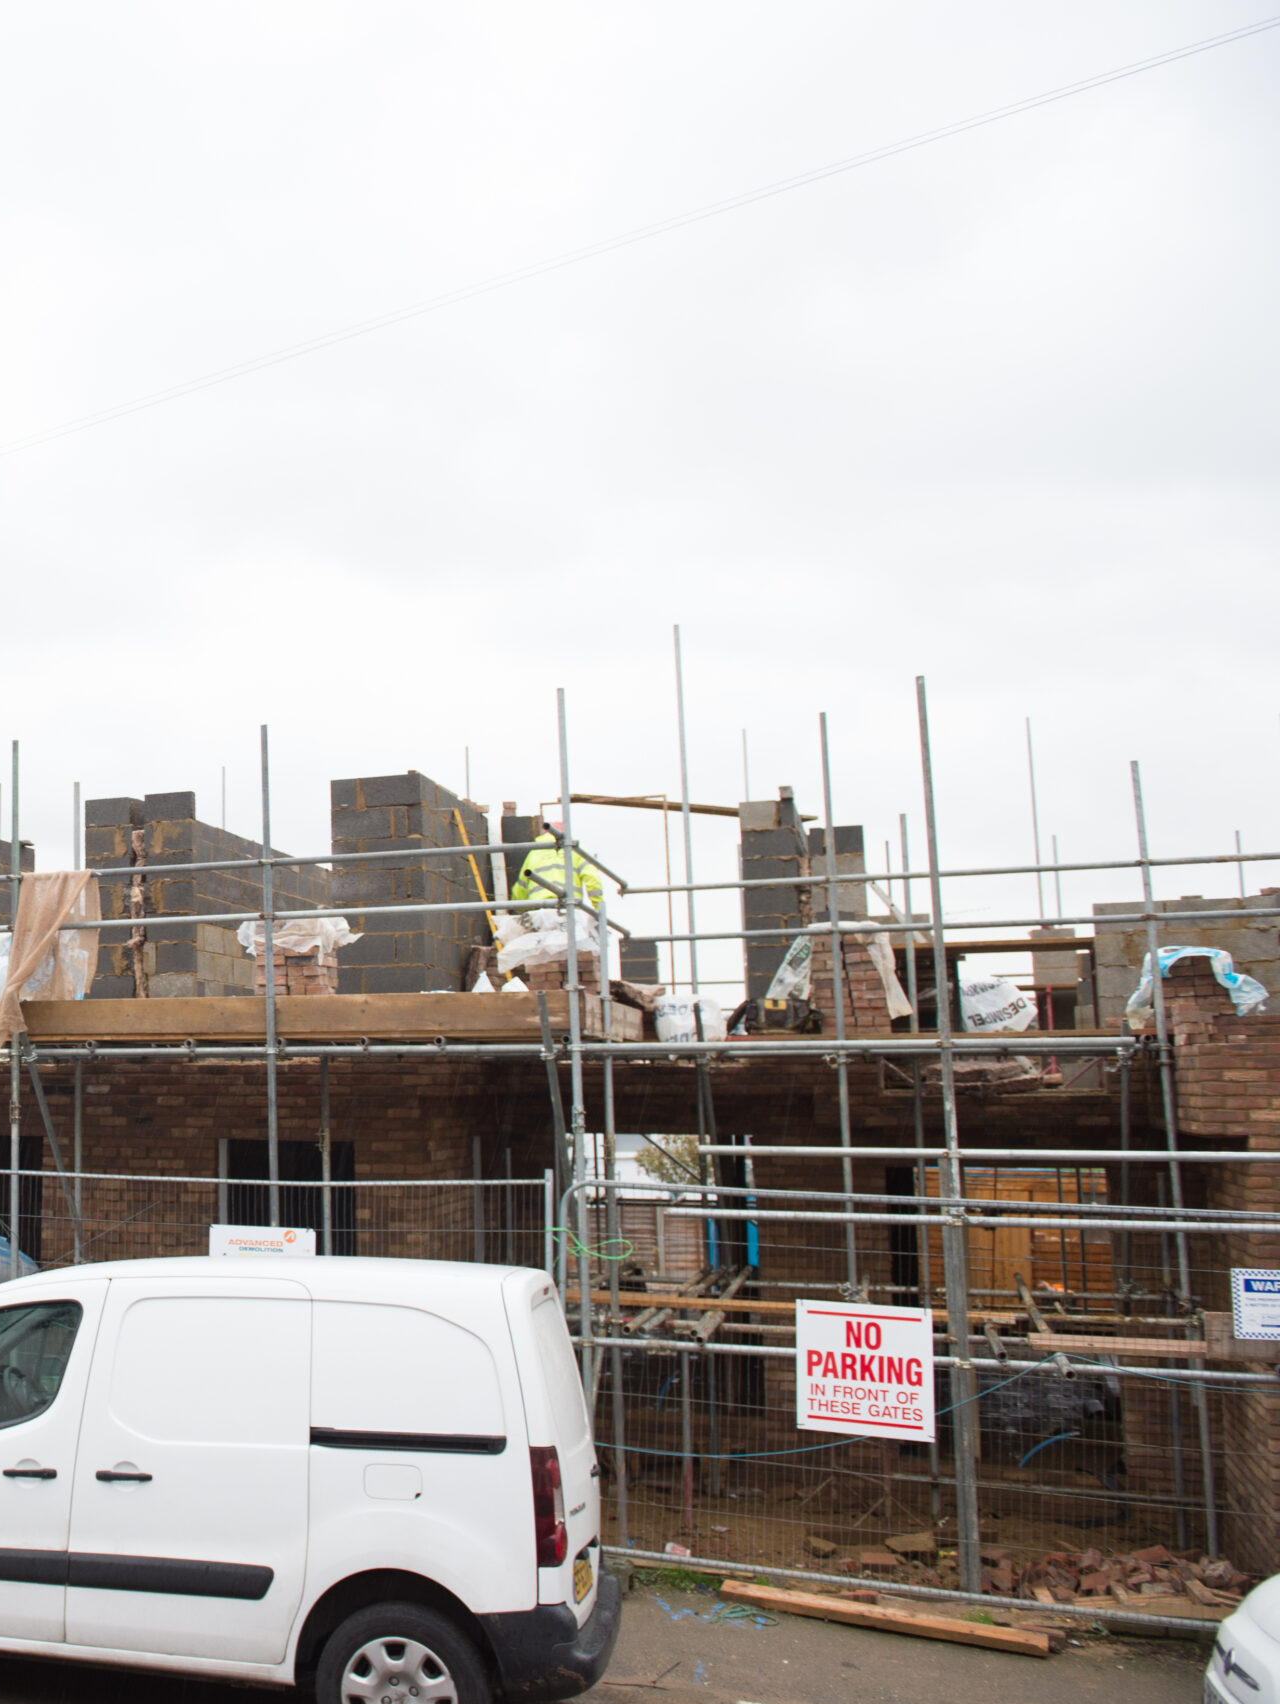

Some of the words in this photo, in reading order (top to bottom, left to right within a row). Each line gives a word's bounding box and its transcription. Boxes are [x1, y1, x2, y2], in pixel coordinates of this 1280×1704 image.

[968, 997, 1027, 1026] DESIMPEL
[228, 1239, 284, 1247] ADVANCED
[845, 1320, 882, 1351] NO
[806, 1349, 923, 1387] PARKING
[810, 1383, 826, 1397] IN
[833, 1385, 889, 1403] FRONT
[896, 1391, 919, 1405] OF
[807, 1397, 862, 1416] THESE
[868, 1404, 924, 1422] GATES
